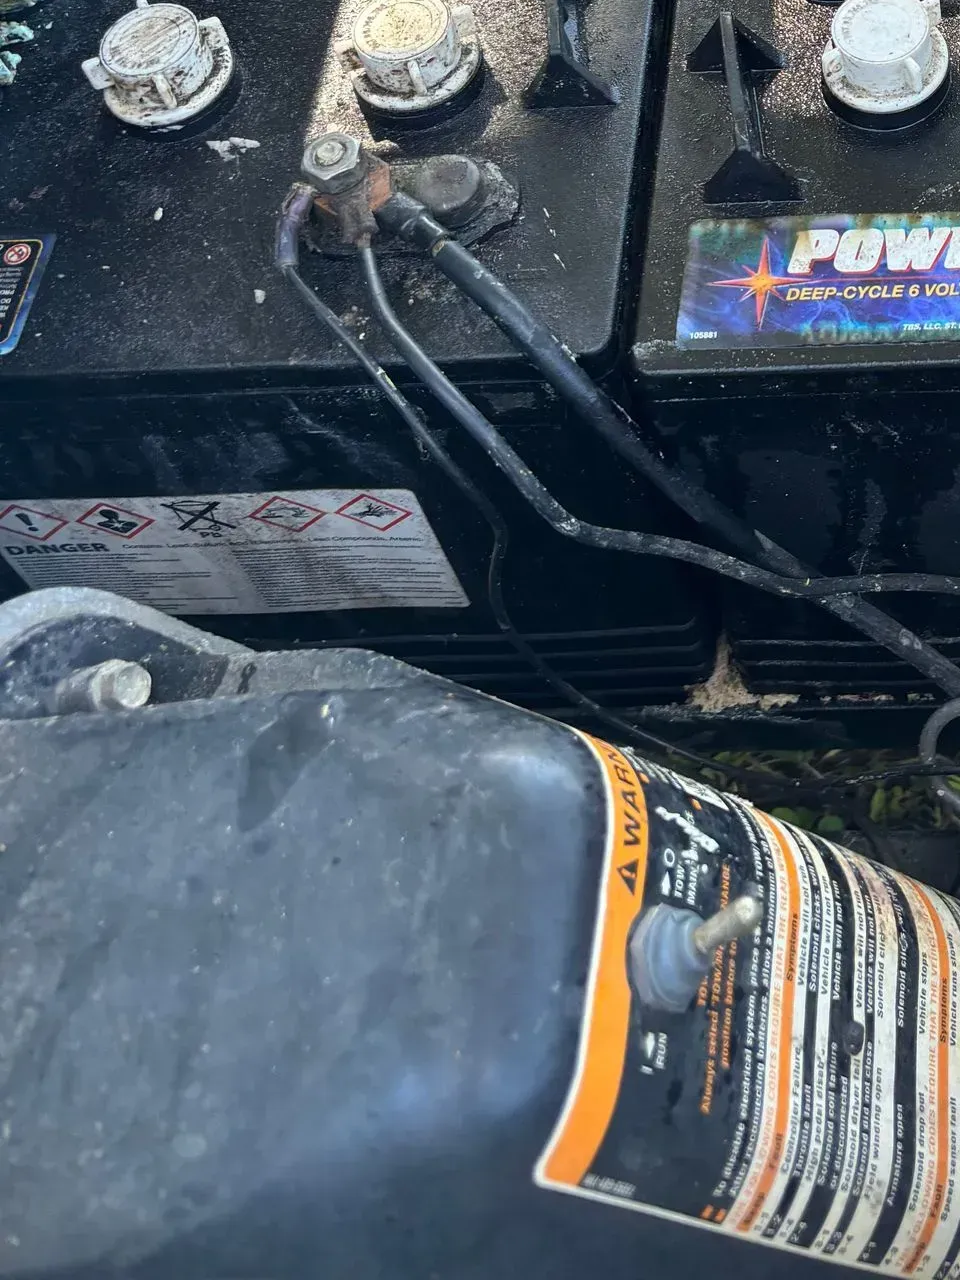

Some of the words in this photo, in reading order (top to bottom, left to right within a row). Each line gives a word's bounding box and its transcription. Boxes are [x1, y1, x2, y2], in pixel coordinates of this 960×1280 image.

[786, 284, 904, 301] DEEP-CYCLE
[908, 282, 922, 297] 6
[5, 542, 110, 556] DANGER
[799, 864, 809, 887] run
[807, 865, 818, 887] will
[831, 880, 841, 900] run
[765, 872, 778, 934] minimum
[801, 890, 810, 907] not
[823, 895, 833, 917] not
[834, 901, 844, 921] not
[853, 890, 863, 910] run
[863, 894, 873, 914] run
[799, 909, 810, 933] will
[822, 920, 832, 945] will
[834, 924, 844, 950] will
[855, 911, 865, 931] not
[866, 916, 876, 937] not
[784, 912, 799, 981] Symptoms
[797, 938, 809, 986] Vehicle
[808, 931, 821, 993] Solenoid
[855, 934, 865, 958] will
[866, 940, 875, 964] will
[945, 932, 957, 968] slowly
[725, 959, 738, 1005] before
[761, 950, 773, 989] allow
[820, 947, 831, 997] Vehicle
[832, 952, 843, 1002] Vehicle
[855, 961, 865, 1010] Vehicle
[919, 951, 929, 985] stops
[950, 971, 958, 997] runs
[865, 966, 875, 1015] Vehicle
[877, 961, 887, 1019] Solenoid
[897, 970, 908, 1028] Solenoid
[929, 981, 939, 1005] THE
[939, 977, 949, 1044] Symptoms
[918, 988, 928, 1036] Vehicle
[928, 1009, 938, 1041] THAT
[949, 1000, 958, 1048] Vehicle
[654, 1032, 668, 1069] RUN
[707, 1011, 720, 1057] select
[721, 1007, 735, 1070] position
[723, 1121, 747, 1179] disable
[738, 1047, 754, 1121] electrical
[749, 946, 761, 988] place
[827, 1041, 838, 1088] failure
[863, 1041, 873, 1078] close
[927, 1047, 938, 1106] REQUIRE
[699, 1058, 716, 1115] Always
[826, 1091, 835, 1117] coil
[862, 1081, 871, 1104] not
[874, 1067, 884, 1101] open
[917, 1091, 926, 1112] out
[743, 1062, 767, 1162] reconnecting
[781, 1101, 800, 1173] Controller
[791, 1047, 802, 1098] Failure
[792, 1120, 810, 1178] Throttle
[802, 1083, 812, 1119] fault
[833, 1075, 848, 1169] disconnected
[861, 1106, 870, 1130] did
[949, 1096, 958, 1128] fault
[804, 1148, 821, 1182] High
[813, 1103, 826, 1144] pedal
[840, 1130, 858, 1193] Solenoid
[849, 1083, 861, 1125] driver
[871, 1104, 883, 1160] winding
[916, 1117, 927, 1148] drop
[927, 1109, 937, 1156] CODES
[816, 1120, 835, 1187] Solenoid
[851, 1132, 869, 1198] Solenoid
[886, 1140, 904, 1207] Armature
[896, 1103, 906, 1139] open
[948, 1130, 958, 1176] sensor
[728, 1163, 747, 1198] After
[907, 1151, 926, 1213] Solenoid
[930, 1183, 944, 1219] Fault
[940, 1178, 956, 1222] Speed
